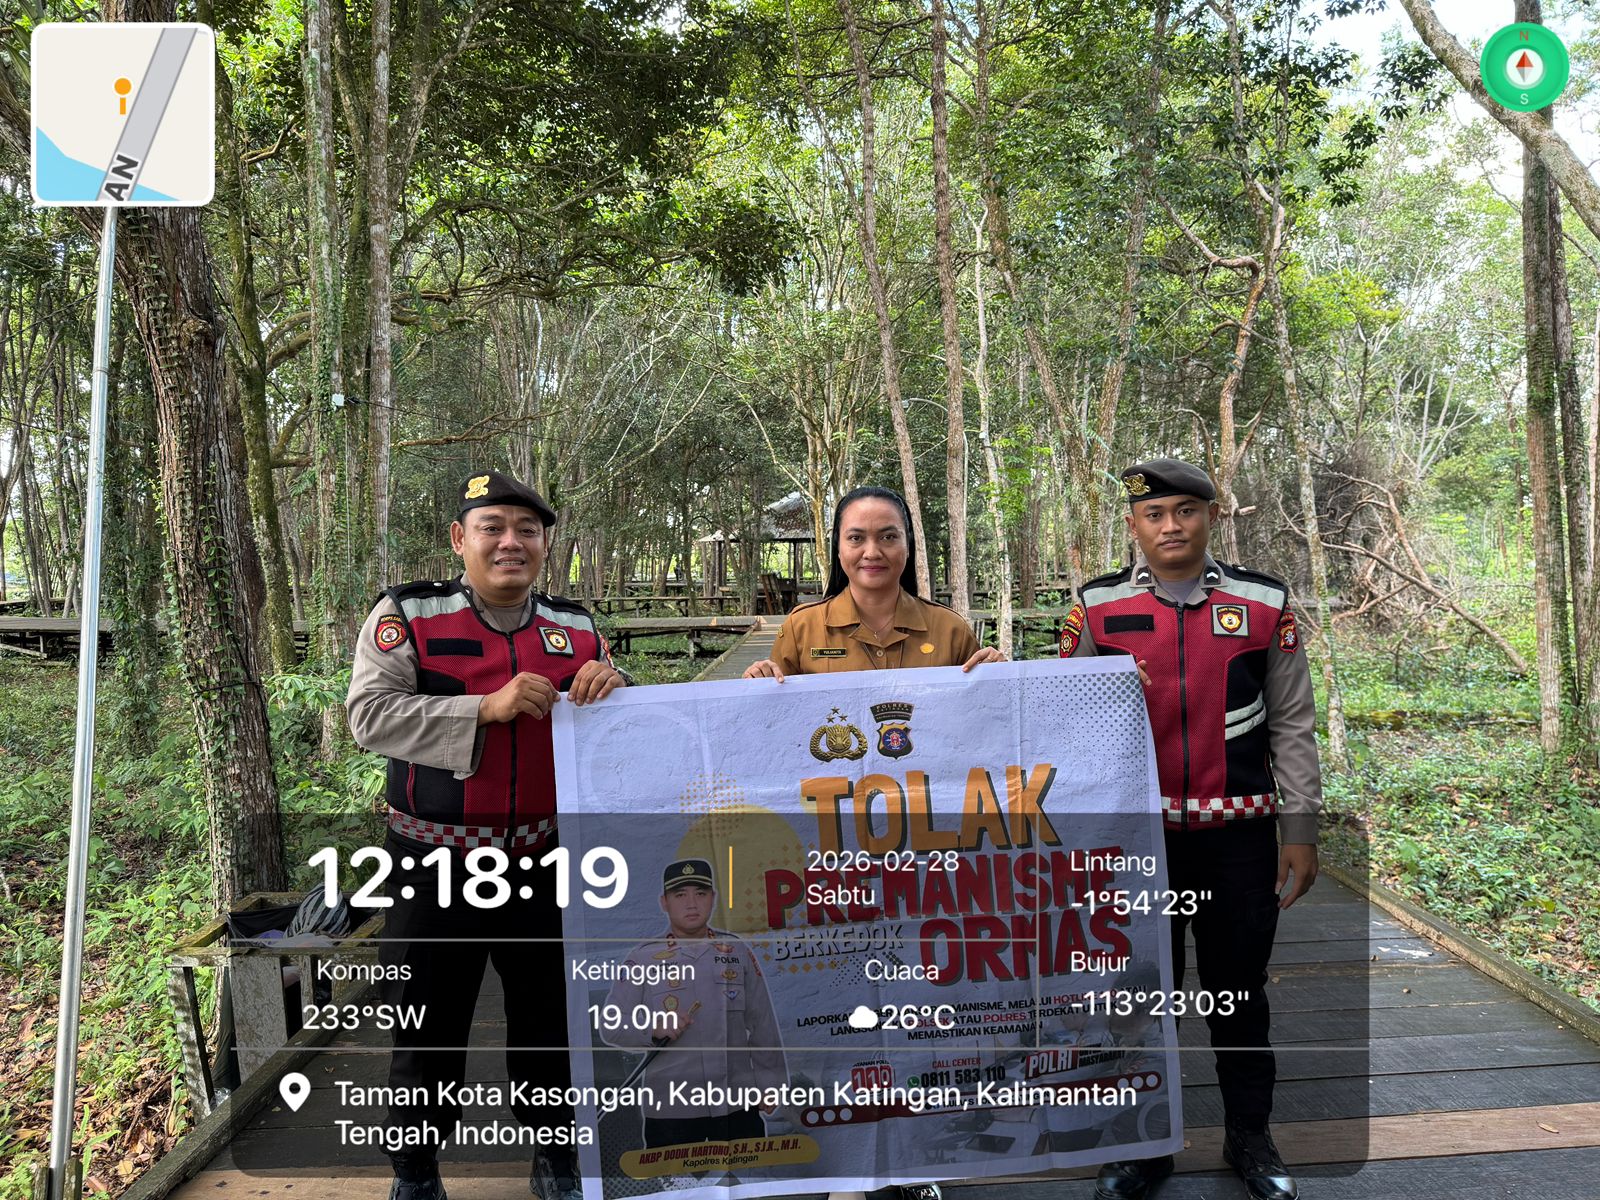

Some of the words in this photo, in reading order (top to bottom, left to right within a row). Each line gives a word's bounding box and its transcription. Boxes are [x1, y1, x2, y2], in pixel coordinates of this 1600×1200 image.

[800, 763, 1062, 861] TOLAK
[765, 846, 1123, 929] PREMANISME
[775, 924, 904, 961] BERKEDOK
[919, 903, 1133, 986] ORMAS
[714, 956, 740, 964] POLRI
[952, 1015, 981, 1025] ATAU
[984, 1012, 1026, 1023] POLRES
[908, 1026, 981, 1040] MEMASTIKAN
[932, 1061, 951, 1069] CALL
[951, 1057, 981, 1067] CENTER
[1028, 1047, 1074, 1078] POLRI
[921, 1071, 950, 1088] 0811
[955, 1068, 981, 1084] 583
[985, 1065, 1006, 1081] 110
[639, 1151, 662, 1165] AKBP
[663, 1148, 689, 1161] DODIK
[683, 1157, 720, 1168] Kapolres
[722, 1154, 759, 1166] Katingan
